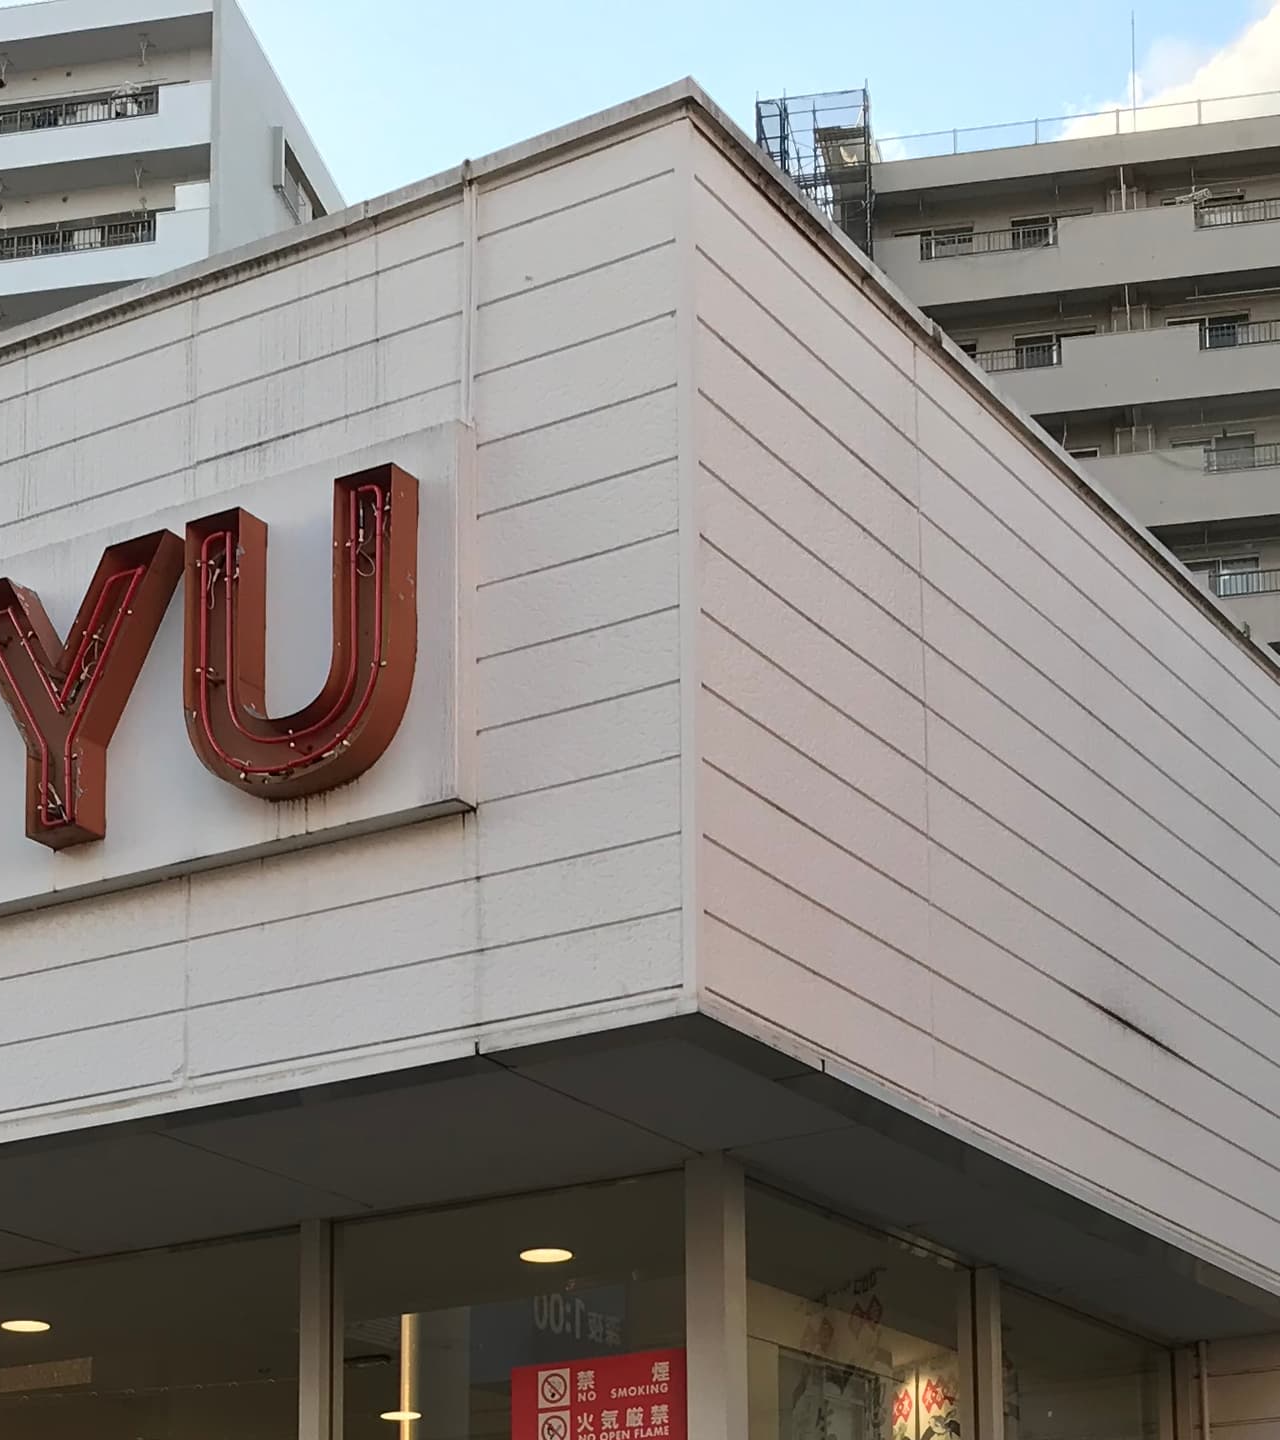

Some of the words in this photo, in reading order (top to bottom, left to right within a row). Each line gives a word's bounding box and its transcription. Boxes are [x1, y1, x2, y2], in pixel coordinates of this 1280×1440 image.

[577, 1392, 597, 1402] NO
[610, 1383, 669, 1399] SMOKING
[634, 1426, 669, 1439] FLAME
